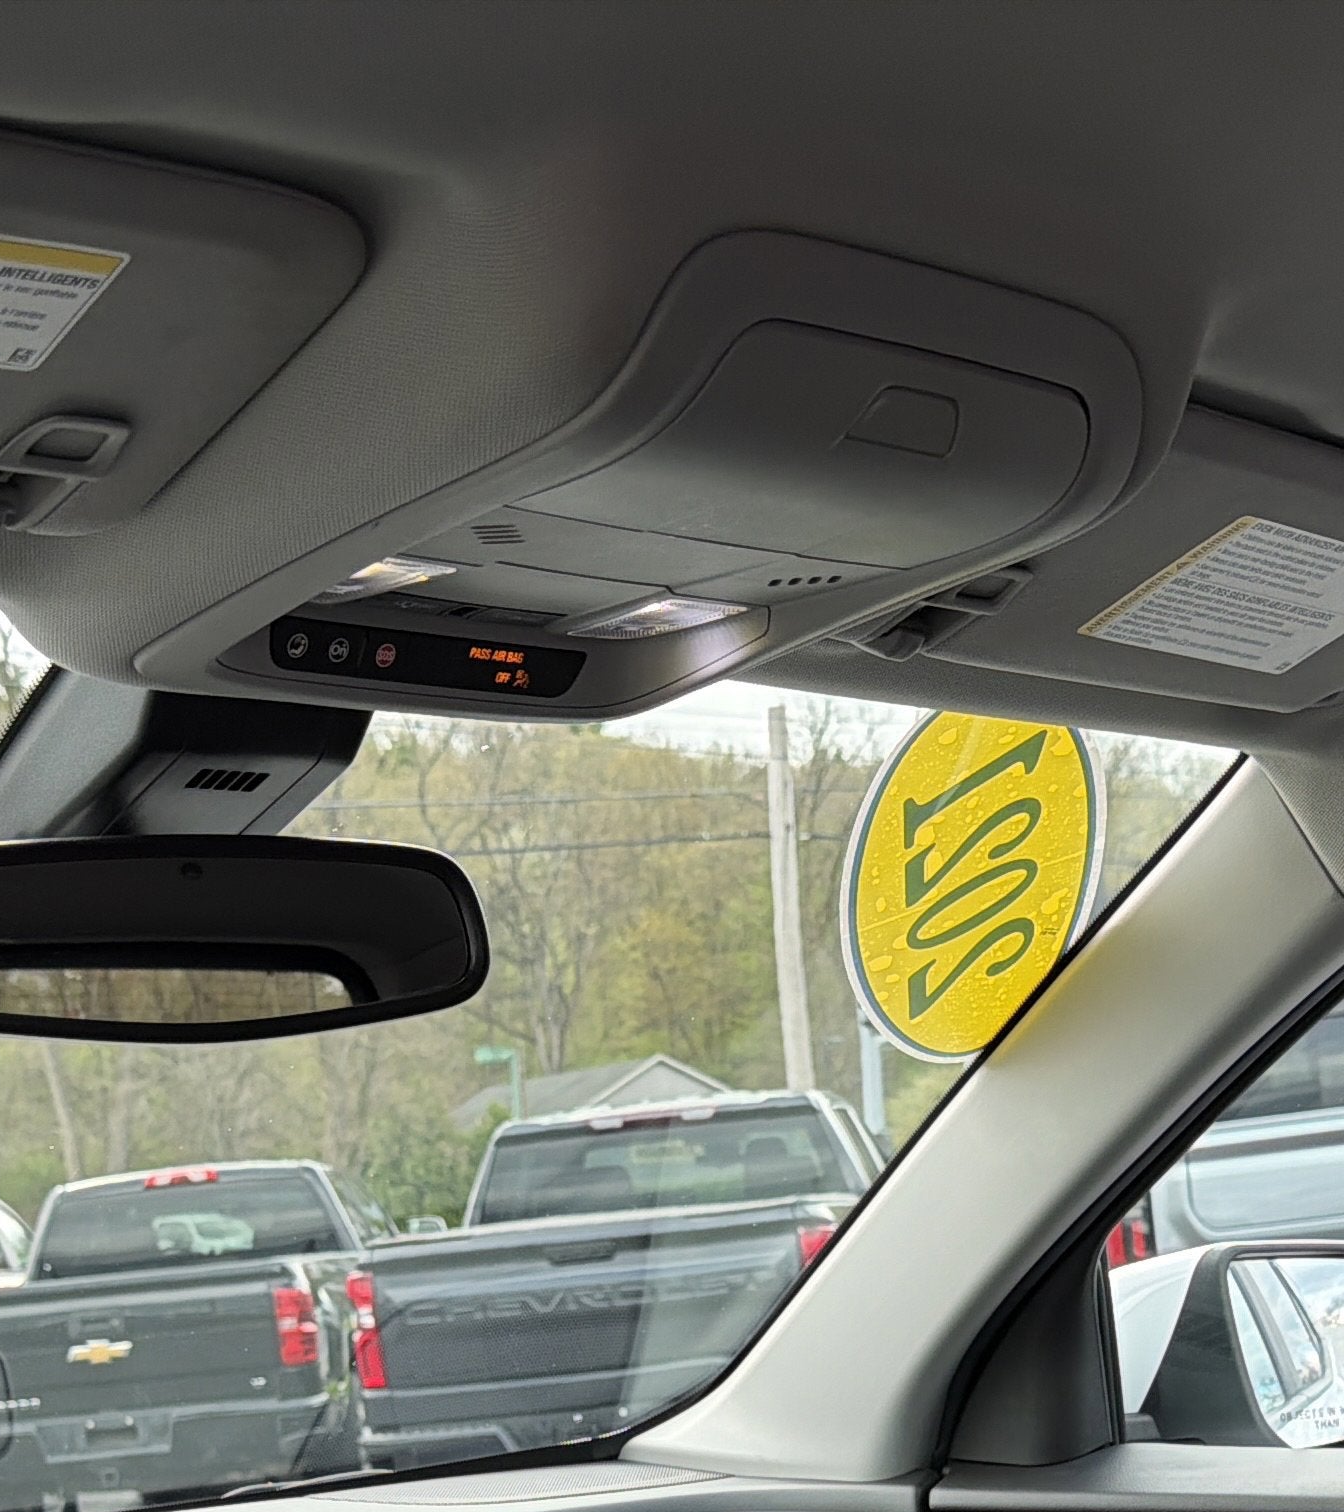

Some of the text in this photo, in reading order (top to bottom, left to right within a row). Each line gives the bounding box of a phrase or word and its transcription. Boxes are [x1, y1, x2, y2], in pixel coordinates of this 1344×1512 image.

[376, 649, 394, 661] SOS
[469, 647, 525, 664] PASS AIR BAG
[495, 671, 511, 685] OFF
